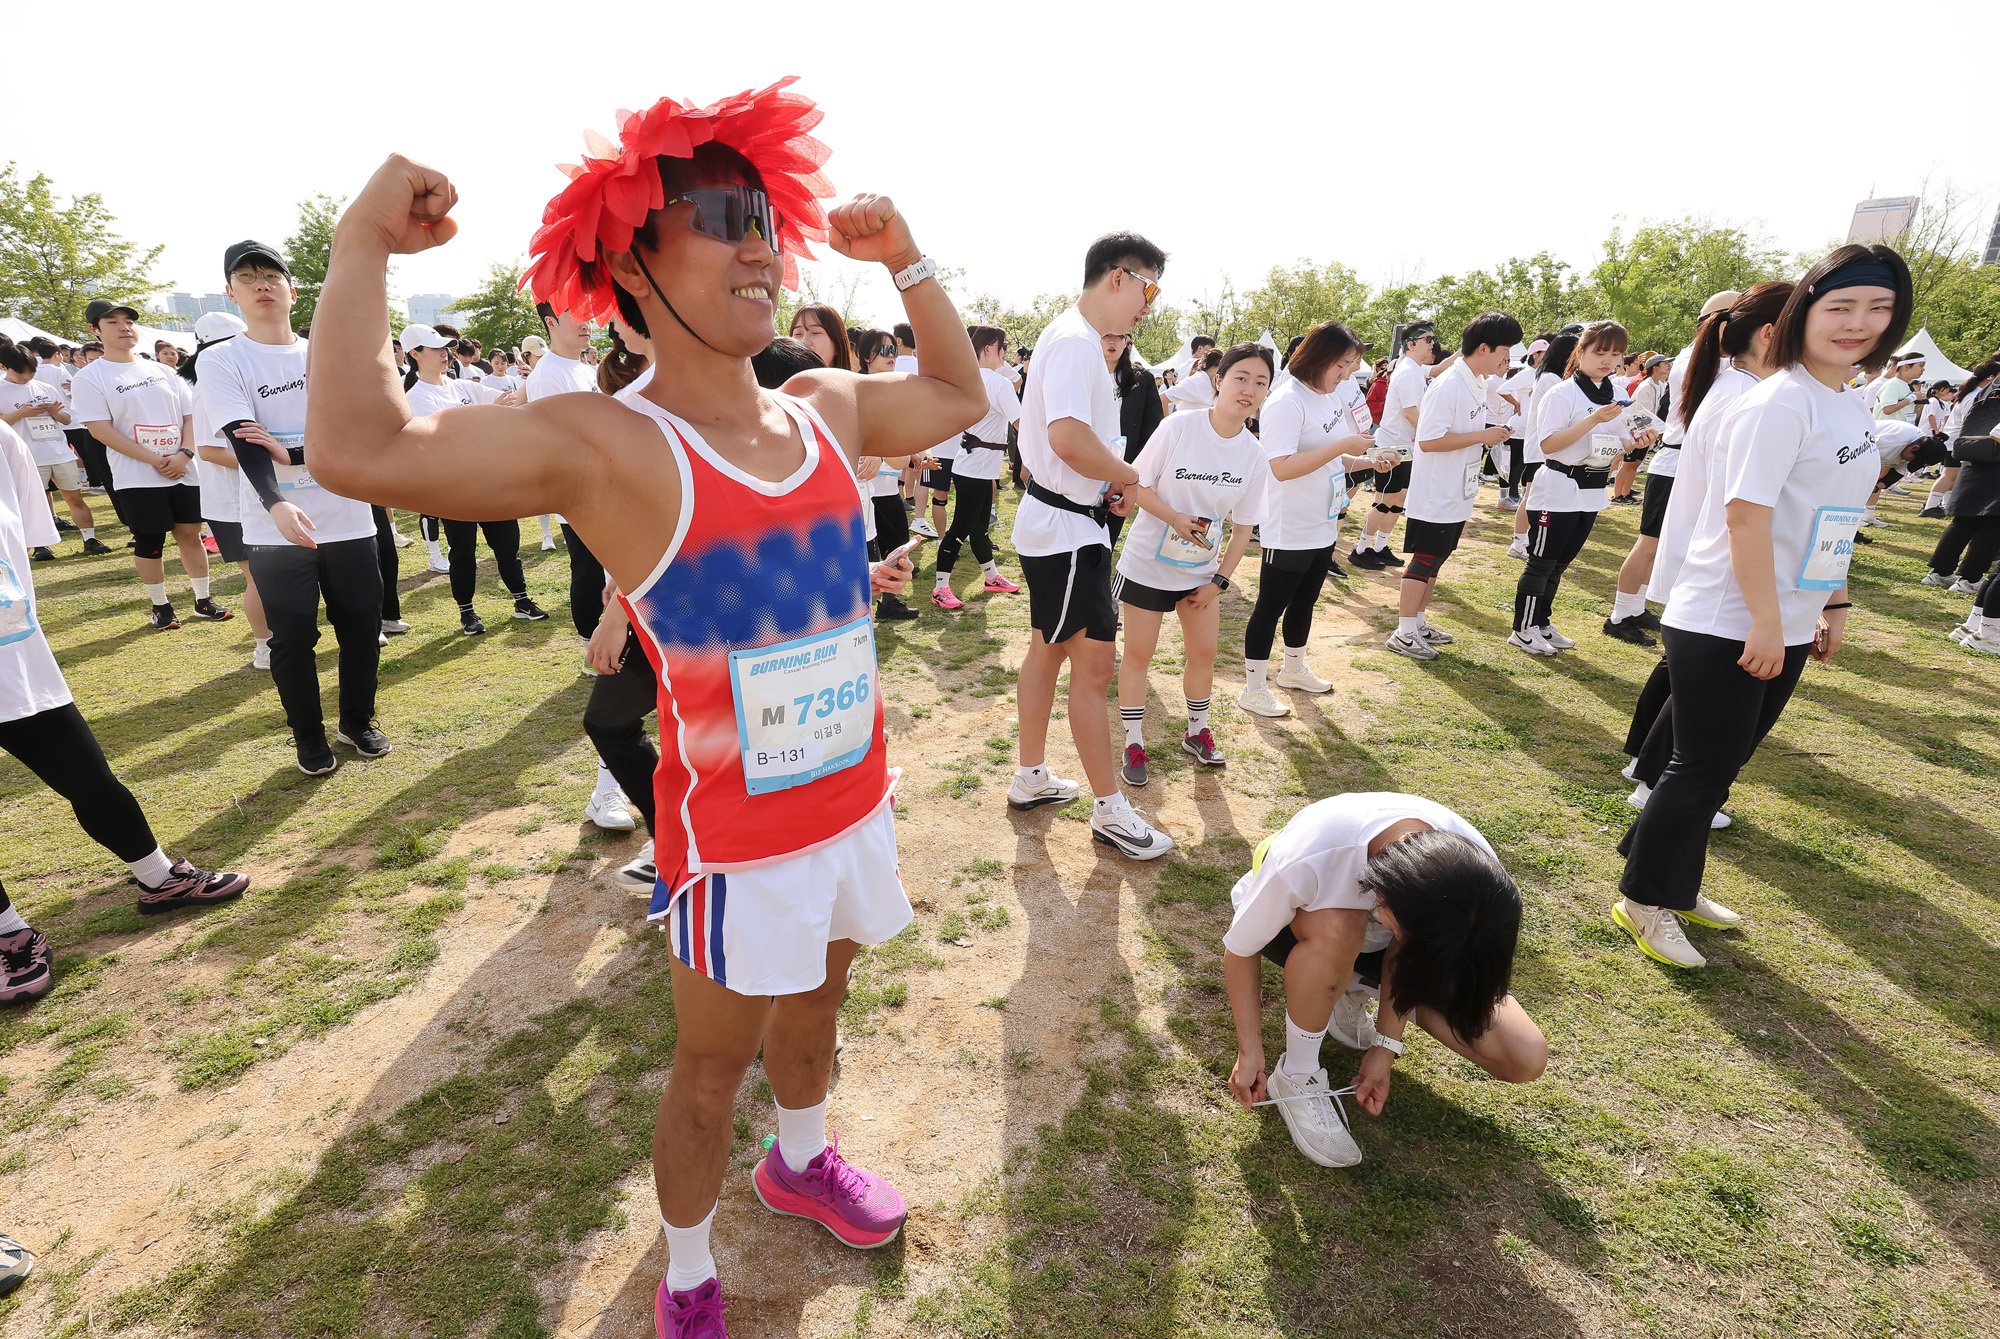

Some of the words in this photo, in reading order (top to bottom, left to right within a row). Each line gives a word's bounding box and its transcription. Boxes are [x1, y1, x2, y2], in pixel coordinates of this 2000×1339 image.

[116, 381, 149, 394] Burning
[258, 379, 305, 399] Burning
[152, 436, 179, 446] 1567
[1836, 441, 1872, 465] Burning
[1175, 468, 1220, 485] Burning
[1221, 471, 1243, 484] Run
[1824, 513, 1851, 523] BURNING
[1171, 533, 1180, 541] W
[1820, 540, 1833, 552] W
[853, 634, 868, 648] 7km
[750, 651, 811, 677] BURNING
[814, 643, 838, 662] RUN
[783, 666, 801, 675] Casual
[801, 661, 821, 671] Running
[820, 655, 837, 665] Festival
[762, 705, 785, 727] M
[793, 673, 869, 726] 7366
[814, 722, 842, 740] 이길영
[757, 748, 805, 765] B-131
